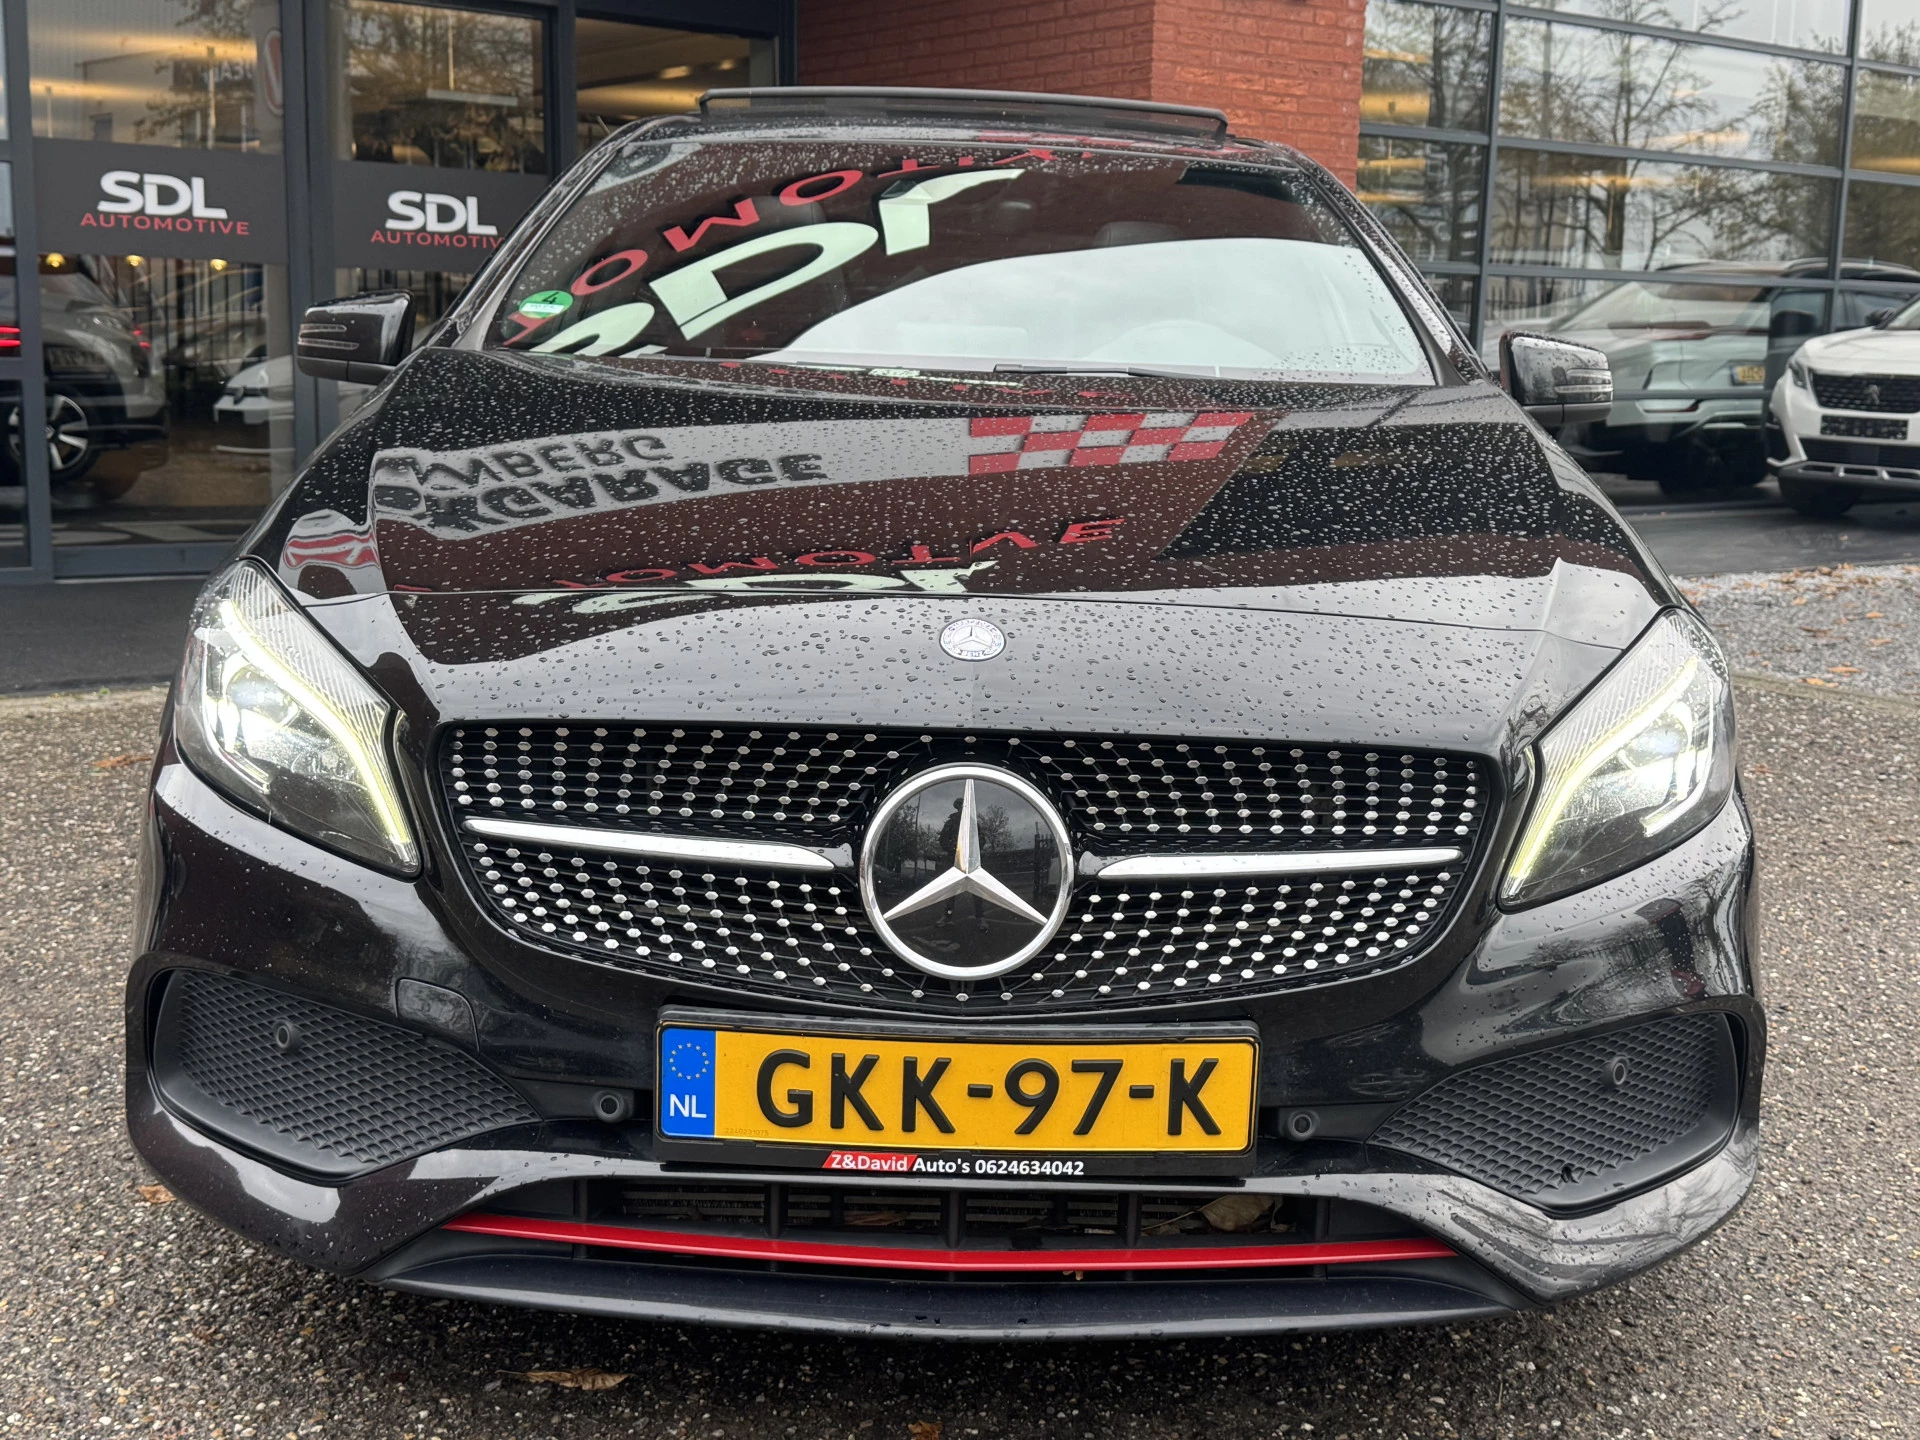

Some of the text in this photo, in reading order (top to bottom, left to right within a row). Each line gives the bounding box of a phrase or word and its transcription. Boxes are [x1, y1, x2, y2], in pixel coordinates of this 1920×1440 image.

[97, 170, 228, 220] SDL
[80, 212, 249, 236] AUTOMOTIVE
[385, 190, 498, 236] SDL
[370, 230, 505, 249] AUTOMOTIV
[541, 291, 559, 304] 4
[756, 1048, 1221, 1136] GKK-97-K
[669, 1093, 707, 1119] NL
[831, 1154, 1084, 1176] Z&David Auto's 0624634042
